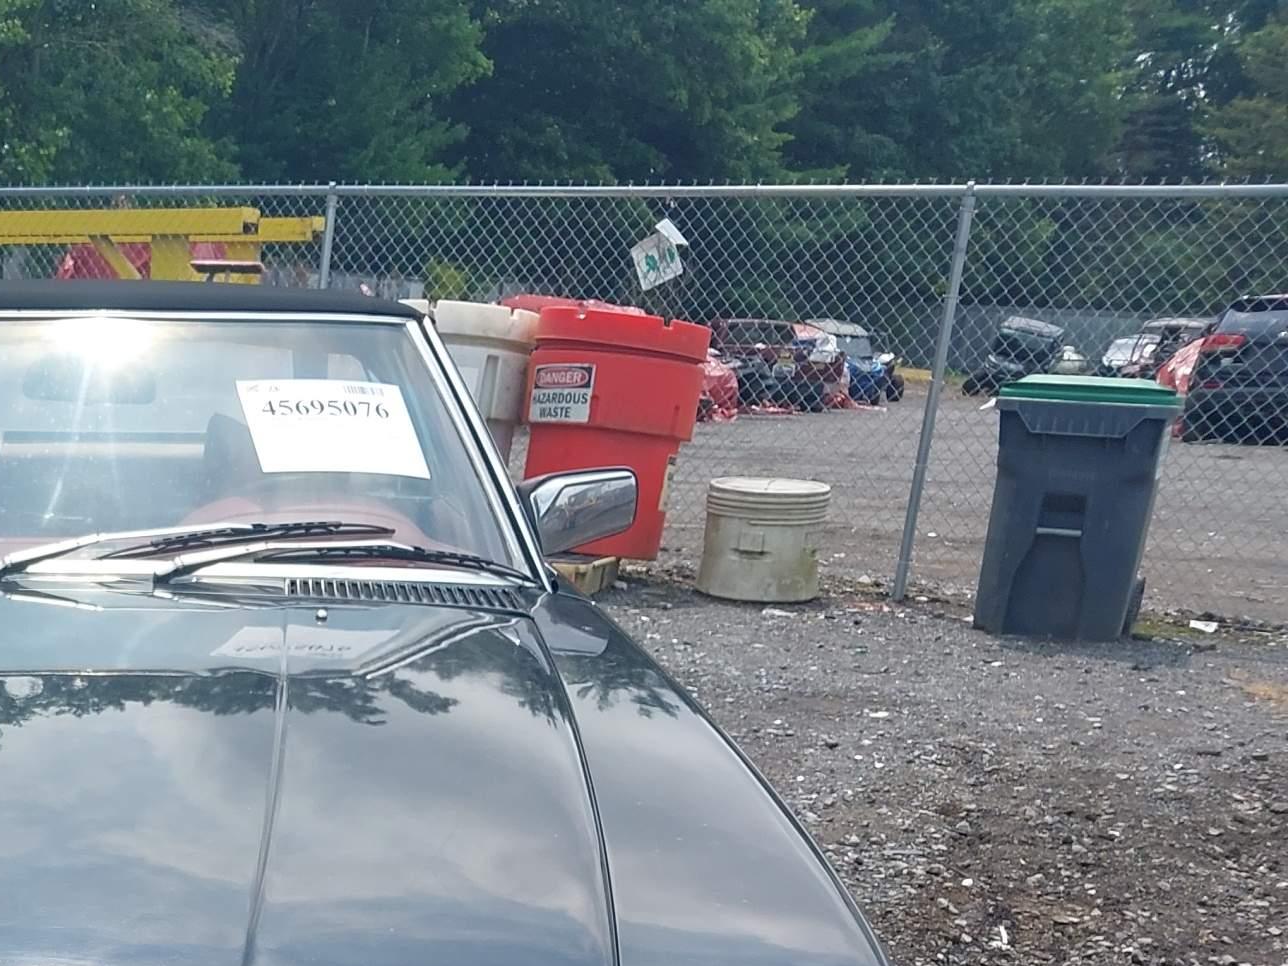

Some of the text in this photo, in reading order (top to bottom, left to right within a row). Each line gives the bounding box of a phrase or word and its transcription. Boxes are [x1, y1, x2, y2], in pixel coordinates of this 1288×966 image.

[539, 370, 583, 384] DANGER
[262, 400, 390, 419] 45695076
[539, 406, 571, 419] WASTE
